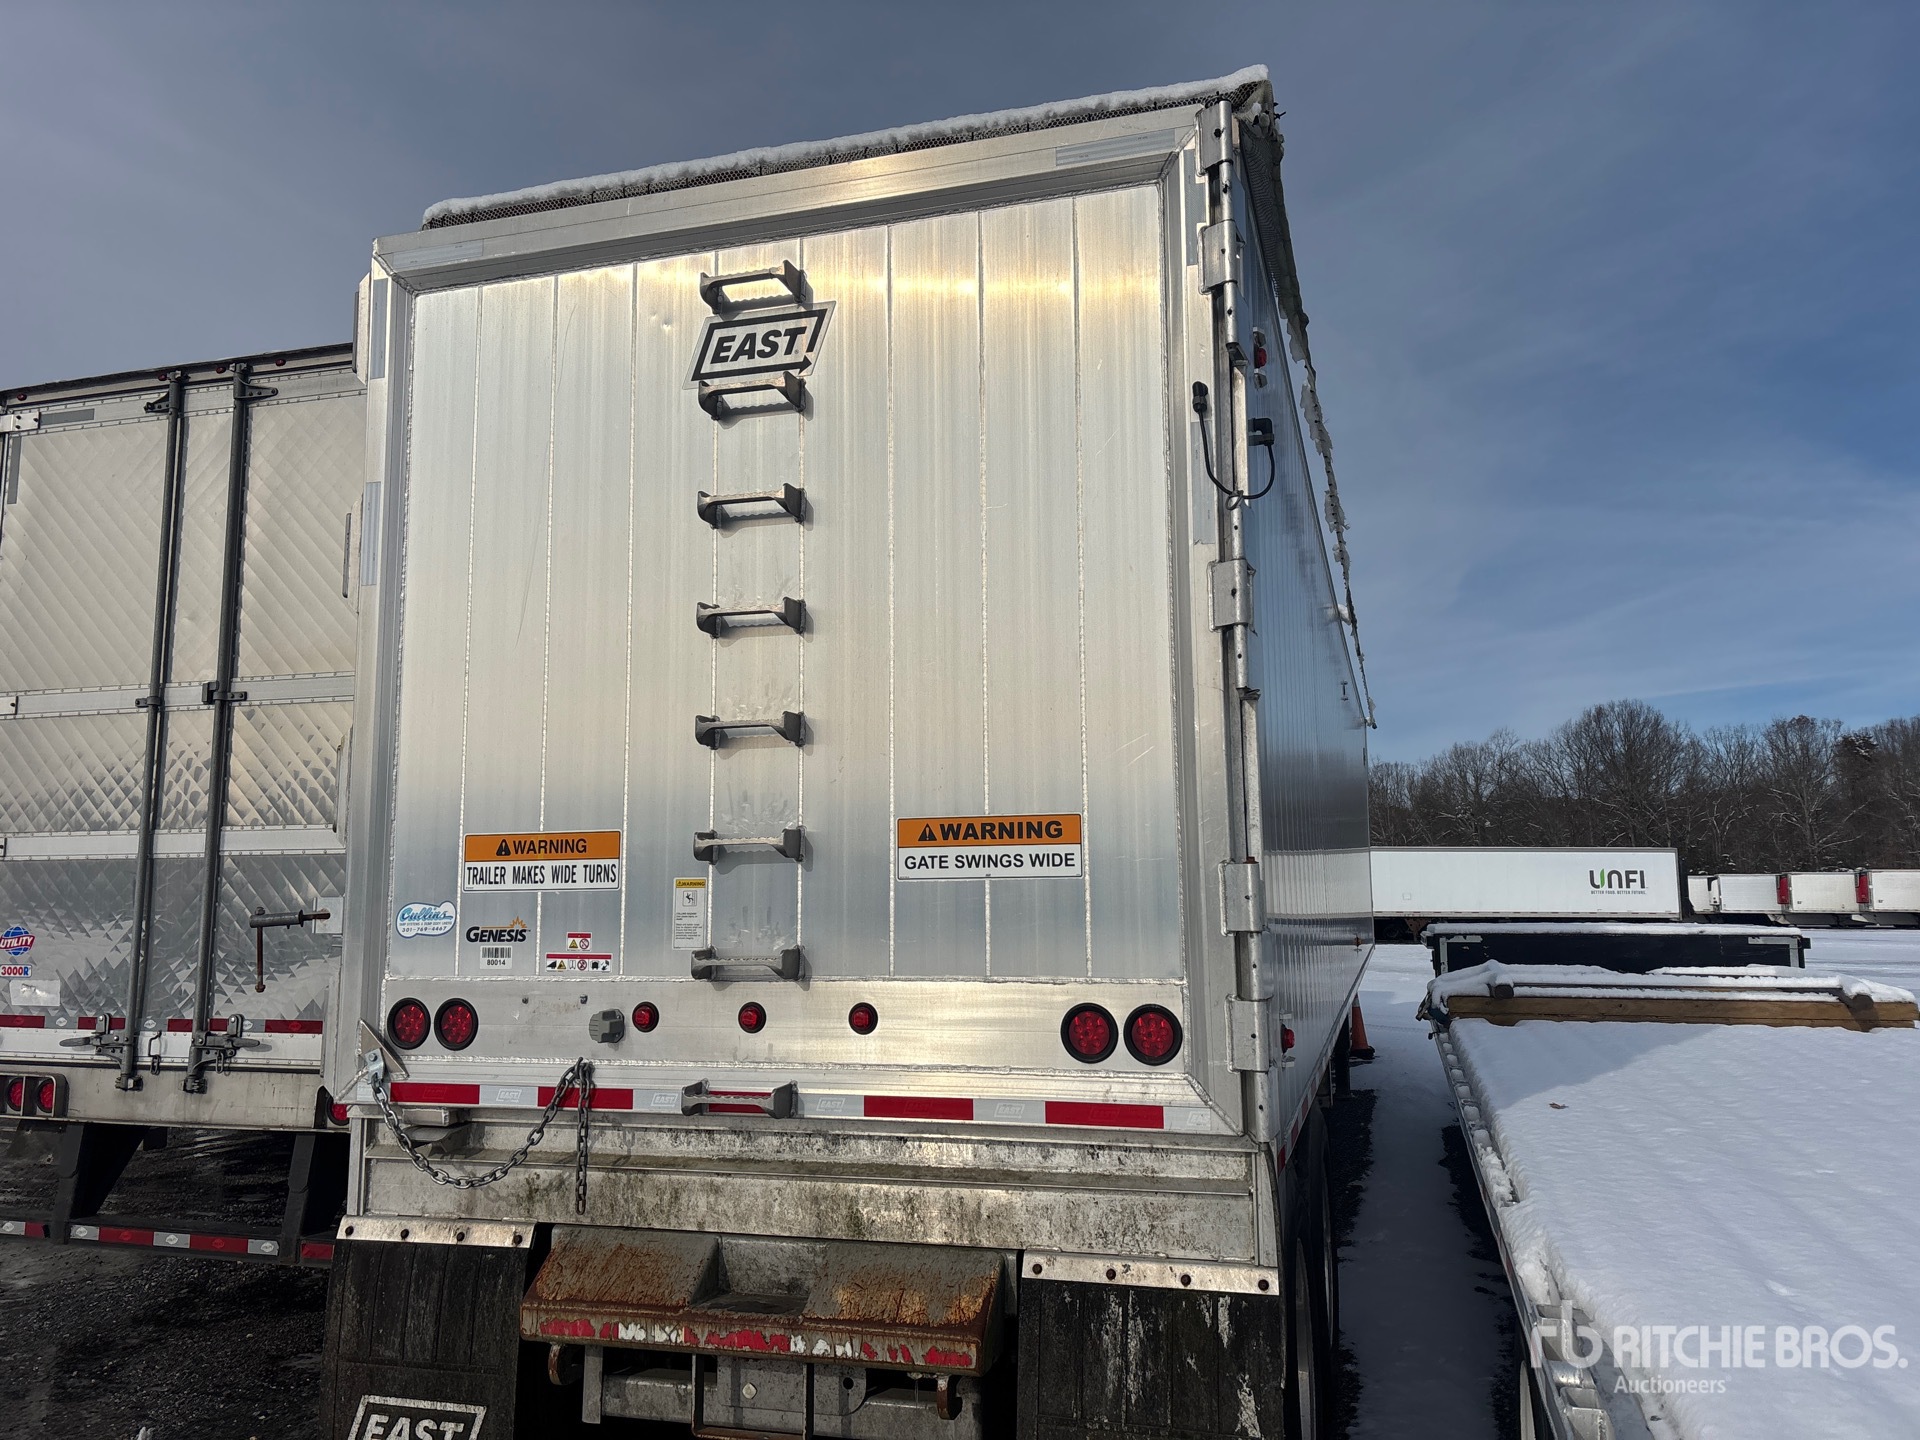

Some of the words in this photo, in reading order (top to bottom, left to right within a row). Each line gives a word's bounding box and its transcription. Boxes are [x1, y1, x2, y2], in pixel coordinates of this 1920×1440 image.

[709, 326, 808, 365] EAST
[939, 820, 1063, 841] WARNING
[513, 838, 588, 855] WARNING
[904, 855, 949, 870] GATE
[954, 854, 1024, 869] SWINGS
[1029, 852, 1076, 868] WIDE
[467, 866, 506, 885] TRAILER
[512, 865, 545, 884] MAKES
[551, 864, 577, 884] WIDE
[583, 863, 617, 883] TURNS
[1589, 868, 1646, 889] UNFI
[399, 906, 454, 922] Cullins
[0, 936, 33, 948] UTILITY
[466, 926, 528, 943] GENESIS
[1, 966, 29, 976] 3000R
[500, 1091, 519, 1100] EAST
[654, 1095, 675, 1104] EAST
[820, 1099, 842, 1109] EAST
[998, 1105, 1021, 1115] EAST
[362, 1413, 465, 1440] EAST
